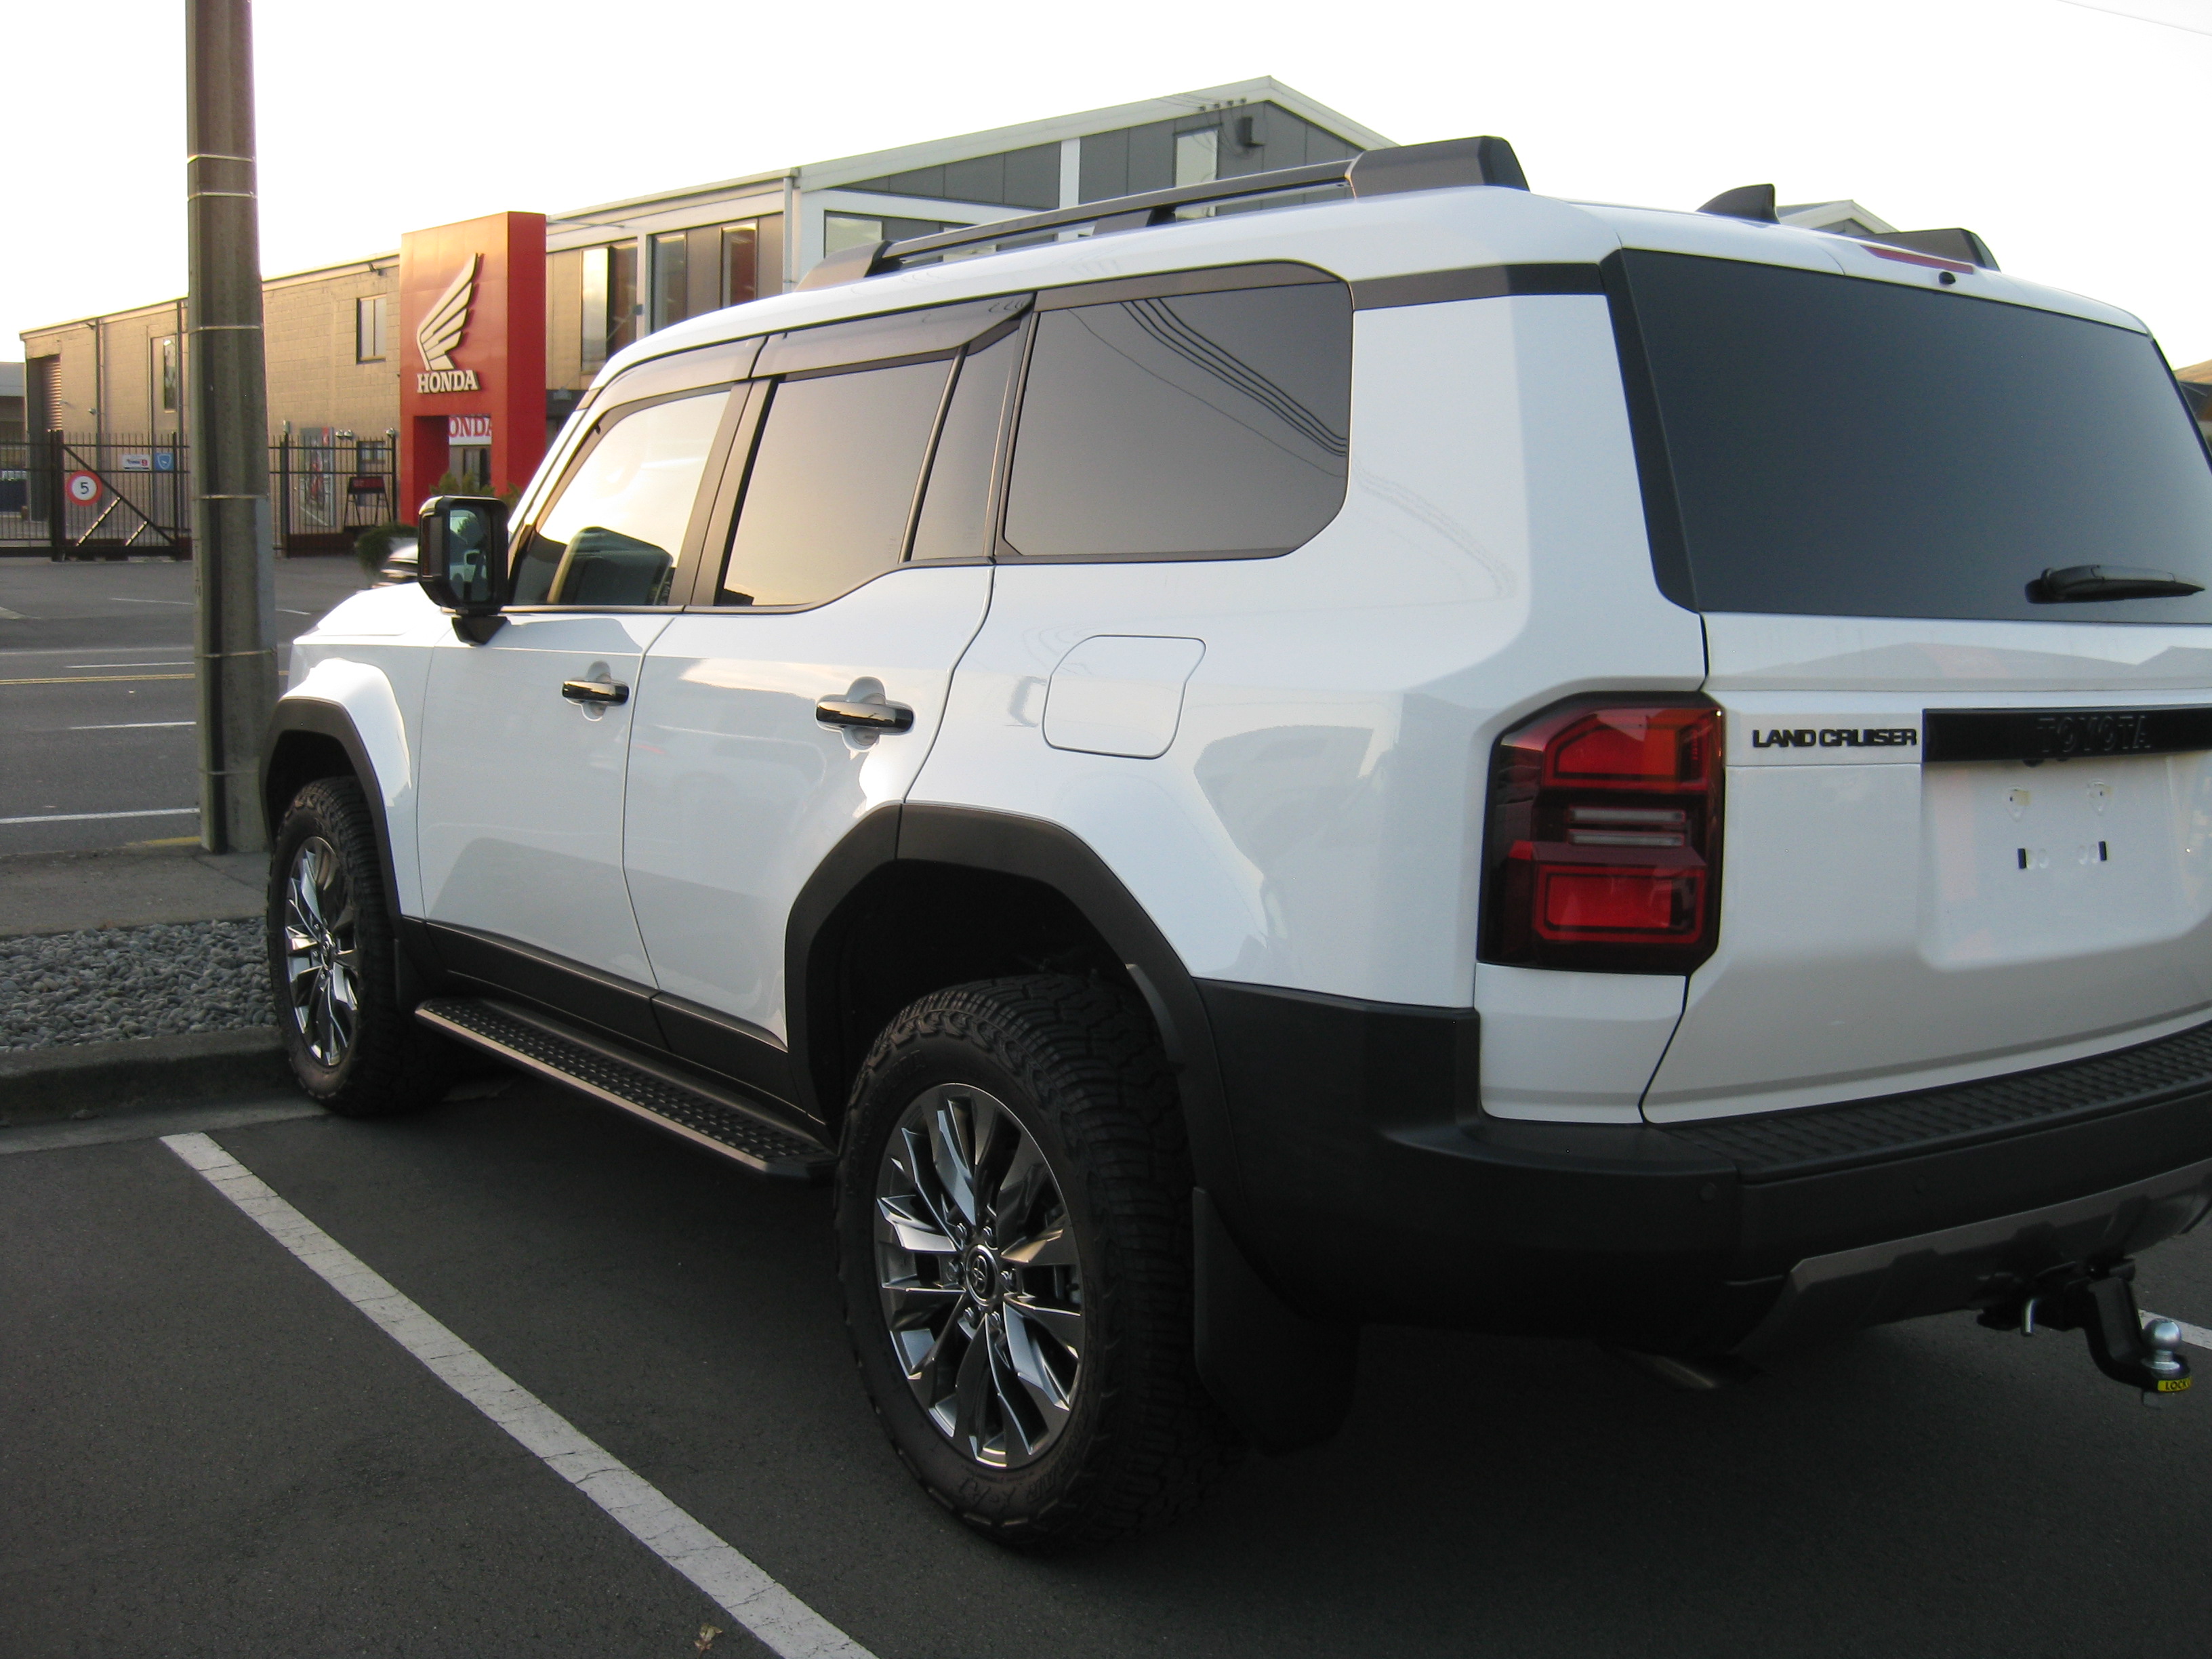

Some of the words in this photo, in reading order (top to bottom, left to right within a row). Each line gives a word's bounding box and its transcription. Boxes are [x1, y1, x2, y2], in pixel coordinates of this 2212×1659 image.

[417, 369, 478, 394] HONDA
[80, 482, 89, 495] 5
[1753, 729, 1816, 747] LAND
[1819, 729, 1917, 747] CRUISER
[2036, 715, 2152, 752] TOYOTA
